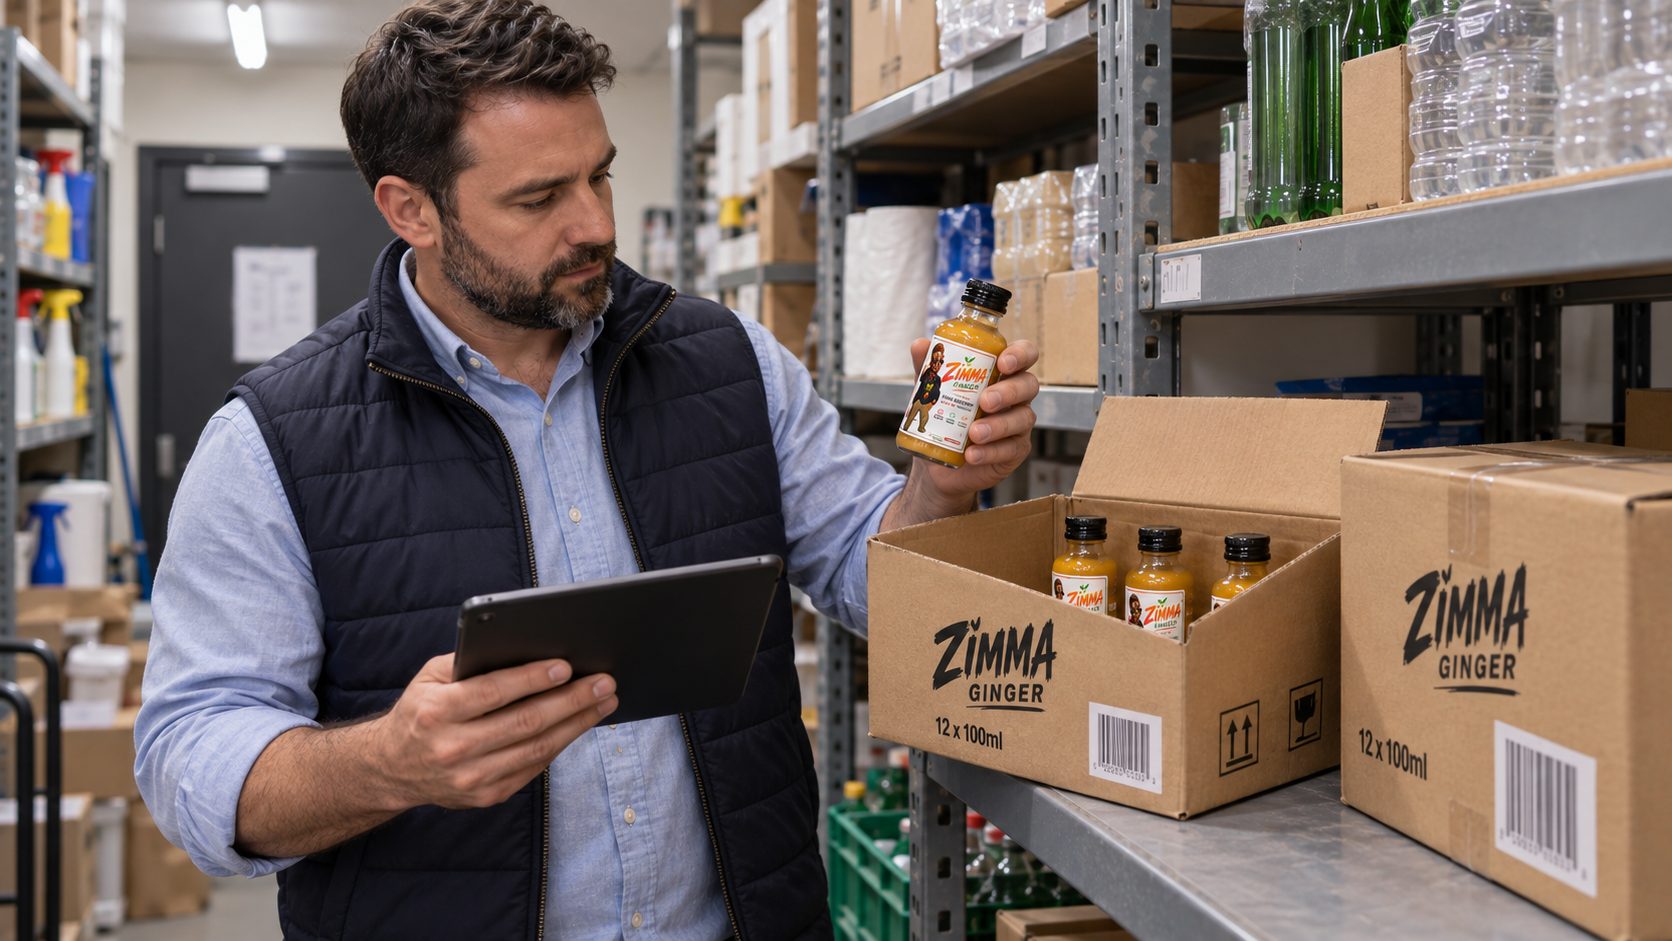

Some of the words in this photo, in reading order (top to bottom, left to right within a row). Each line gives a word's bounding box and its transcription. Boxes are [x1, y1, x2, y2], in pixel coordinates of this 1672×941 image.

[941, 361, 988, 384] ZIMMA
[1143, 603, 1181, 625] ZIMMA
[1403, 563, 1529, 666] ZIMMA
[933, 617, 1057, 690] ZIMMA
[1439, 653, 1516, 680] GINGER
[969, 683, 1044, 703] GINGER
[935, 716, 951, 737] 12
[952, 724, 961, 740] x
[963, 723, 1003, 751] 100ml
[1359, 727, 1374, 758] 12
[1375, 738, 1384, 762] x
[1386, 738, 1428, 781] 100ml
